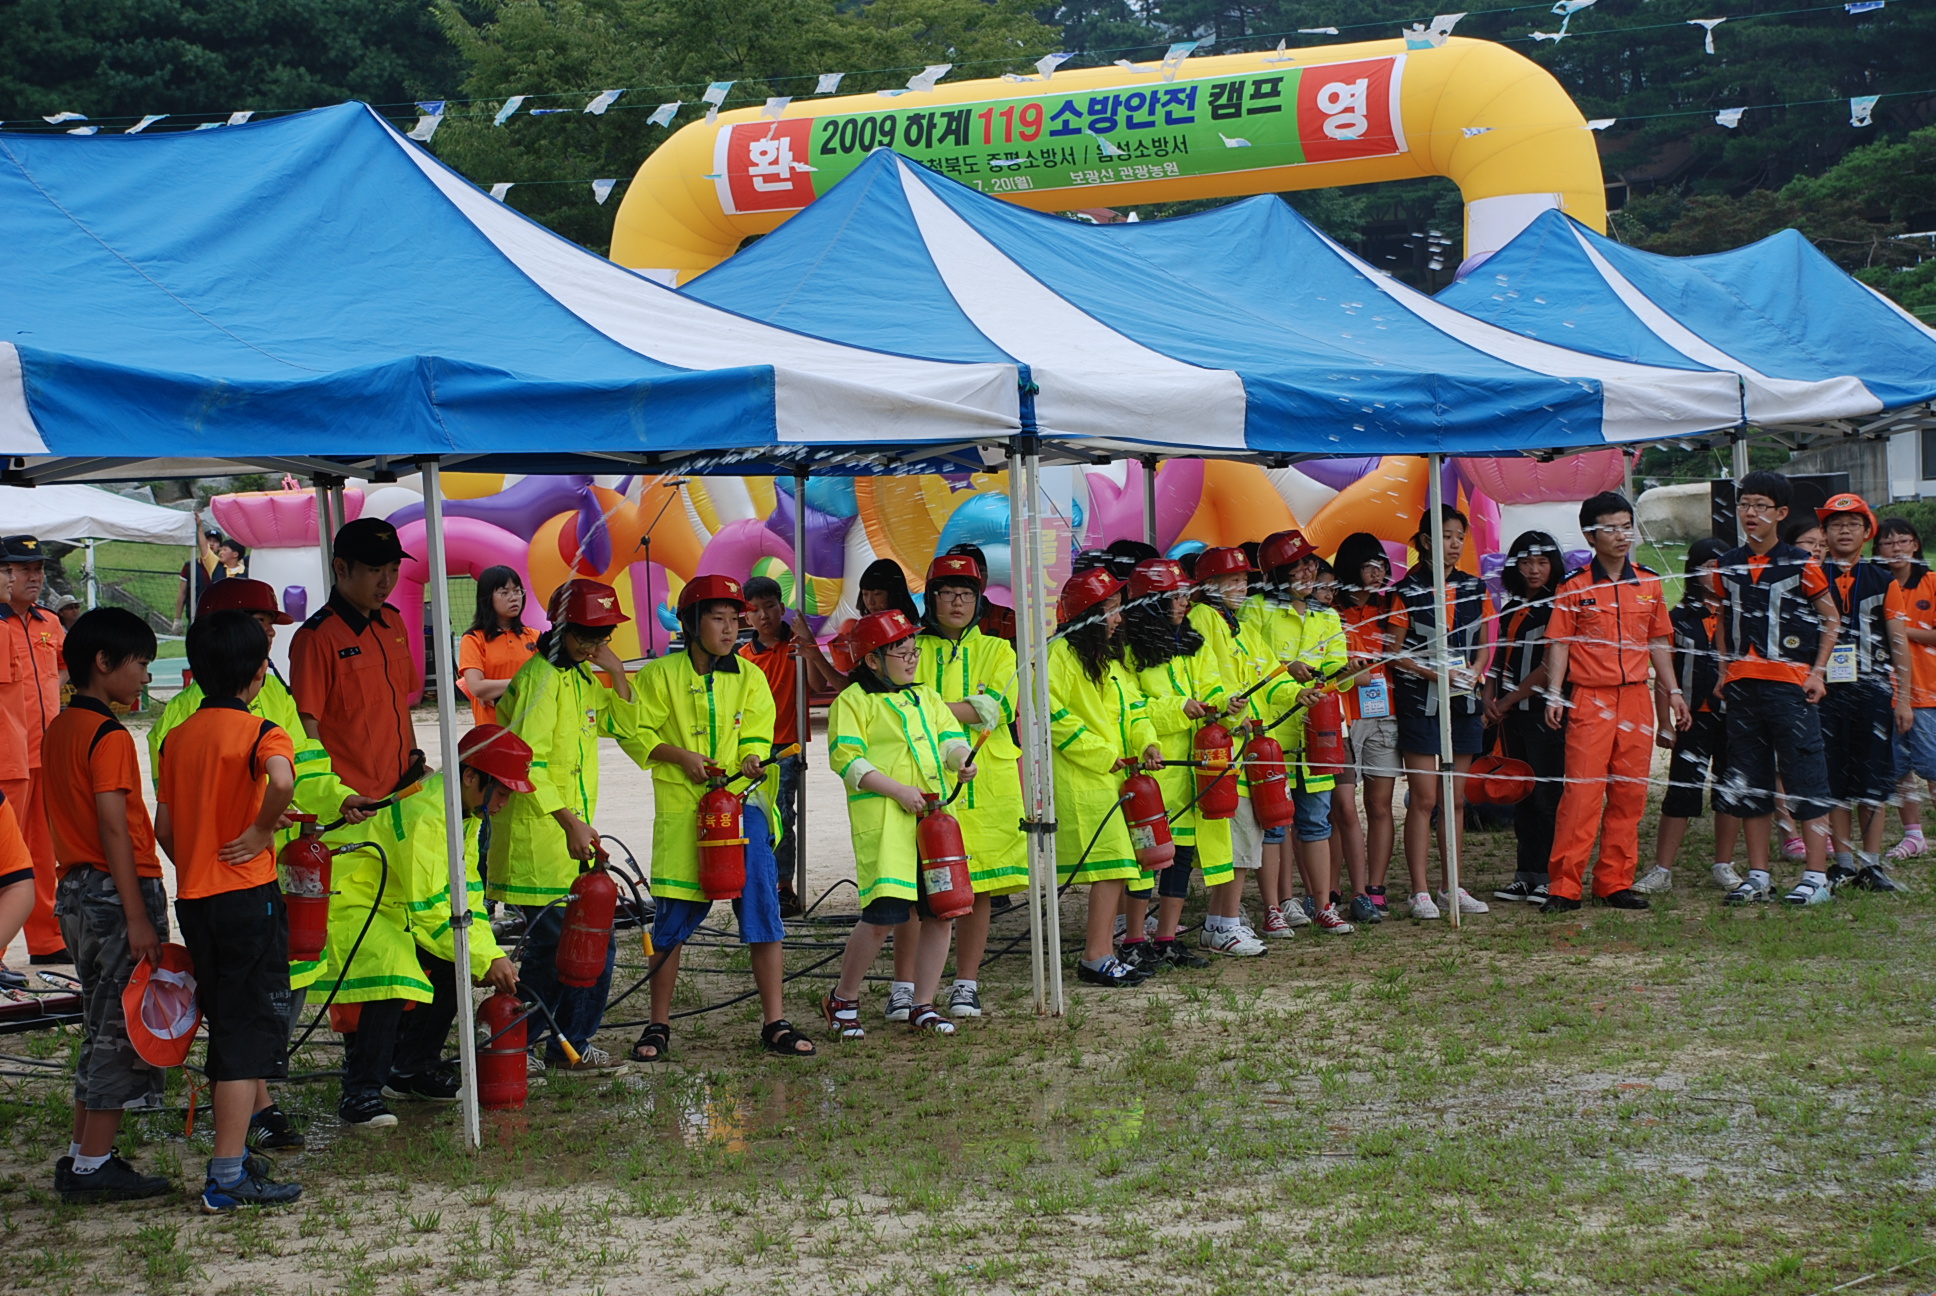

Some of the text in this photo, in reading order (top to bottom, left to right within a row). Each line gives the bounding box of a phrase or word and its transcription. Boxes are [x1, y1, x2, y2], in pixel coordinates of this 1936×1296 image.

[820, 114, 897, 155] 2009
[977, 102, 1045, 145] 119
[1049, 85, 1199, 137] 소방안전
[1208, 77, 1285, 120] 캠프
[1317, 78, 1369, 140] 영
[748, 136, 793, 192] 환
[916, 154, 981, 176] 청북도
